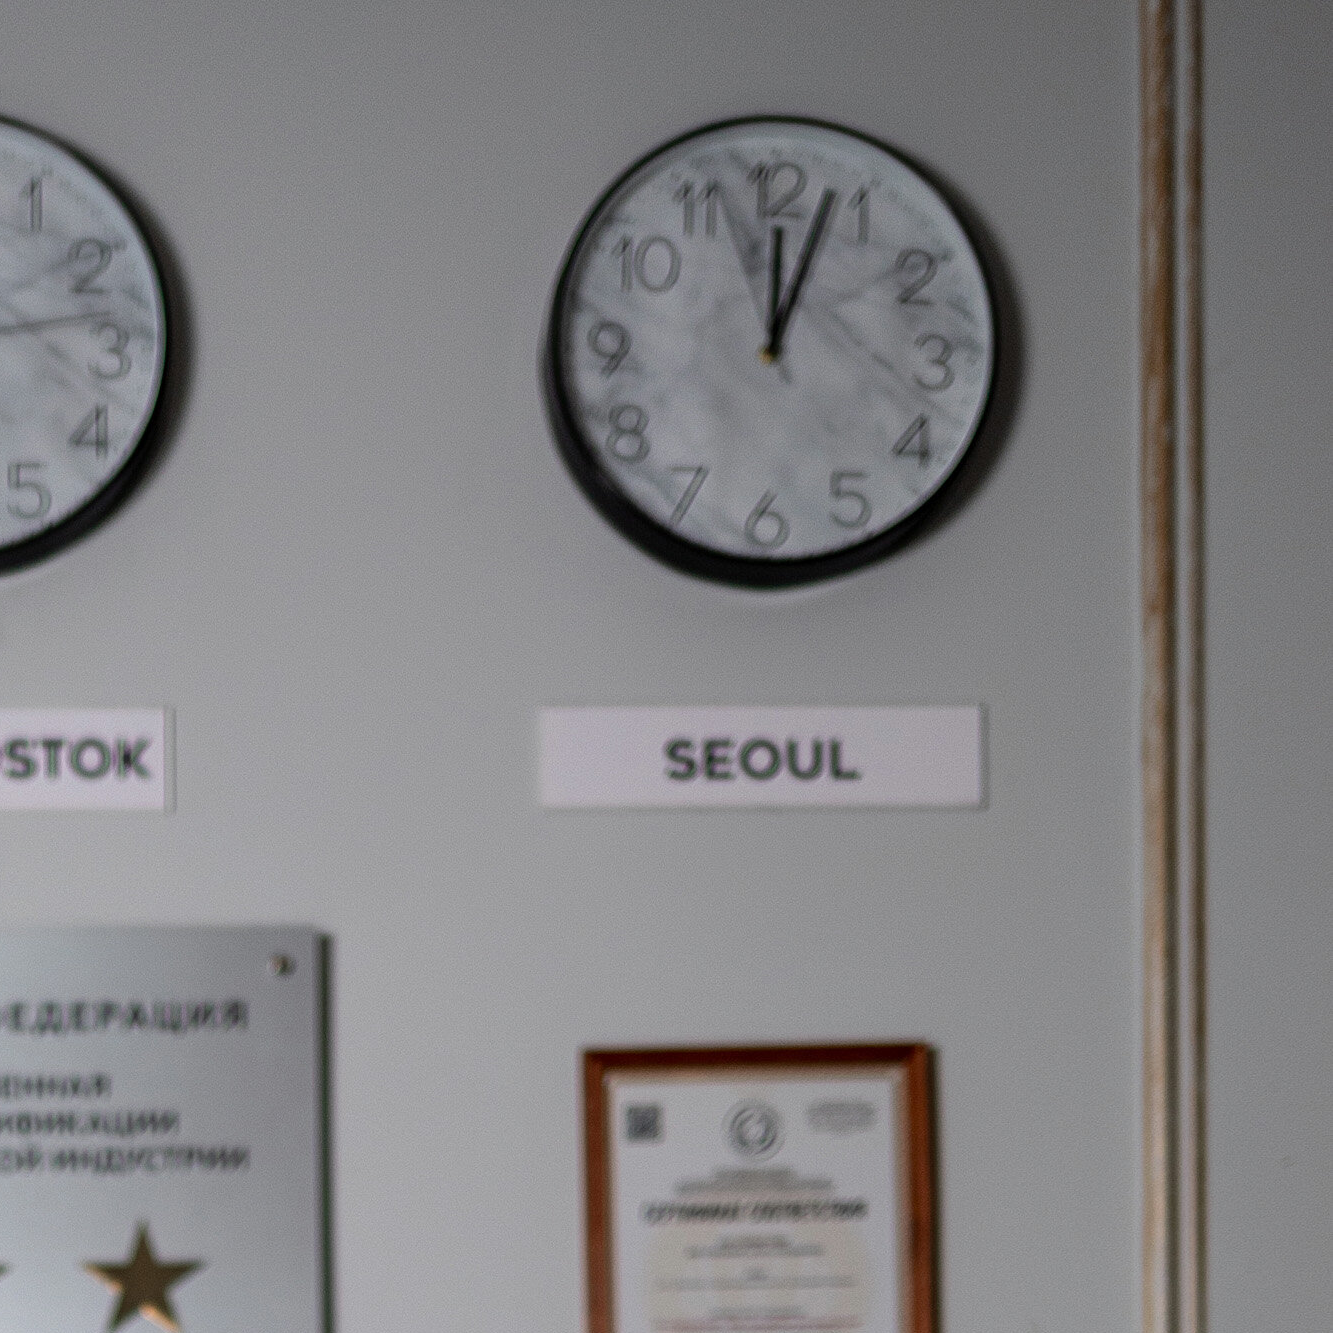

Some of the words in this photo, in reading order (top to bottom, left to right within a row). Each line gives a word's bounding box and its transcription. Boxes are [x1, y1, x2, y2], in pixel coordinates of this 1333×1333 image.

[24, 174, 43, 231] 1
[678, 180, 717, 237] 11
[748, 161, 807, 218] 12
[849, 187, 870, 243] 1
[73, 238, 112, 295] 2
[616, 236, 681, 293] 10
[895, 248, 936, 304] 2
[89, 322, 131, 381] 3
[588, 321, 630, 377] 9
[914, 334, 954, 392] 3
[70, 403, 109, 459] 4
[605, 404, 650, 462] 8
[892, 414, 931, 467] 4
[7, 461, 52, 519] 5
[670, 467, 709, 525] 7
[831, 470, 871, 528] 5
[744, 492, 789, 549] 6
[665, 738, 861, 782] SEOUL
